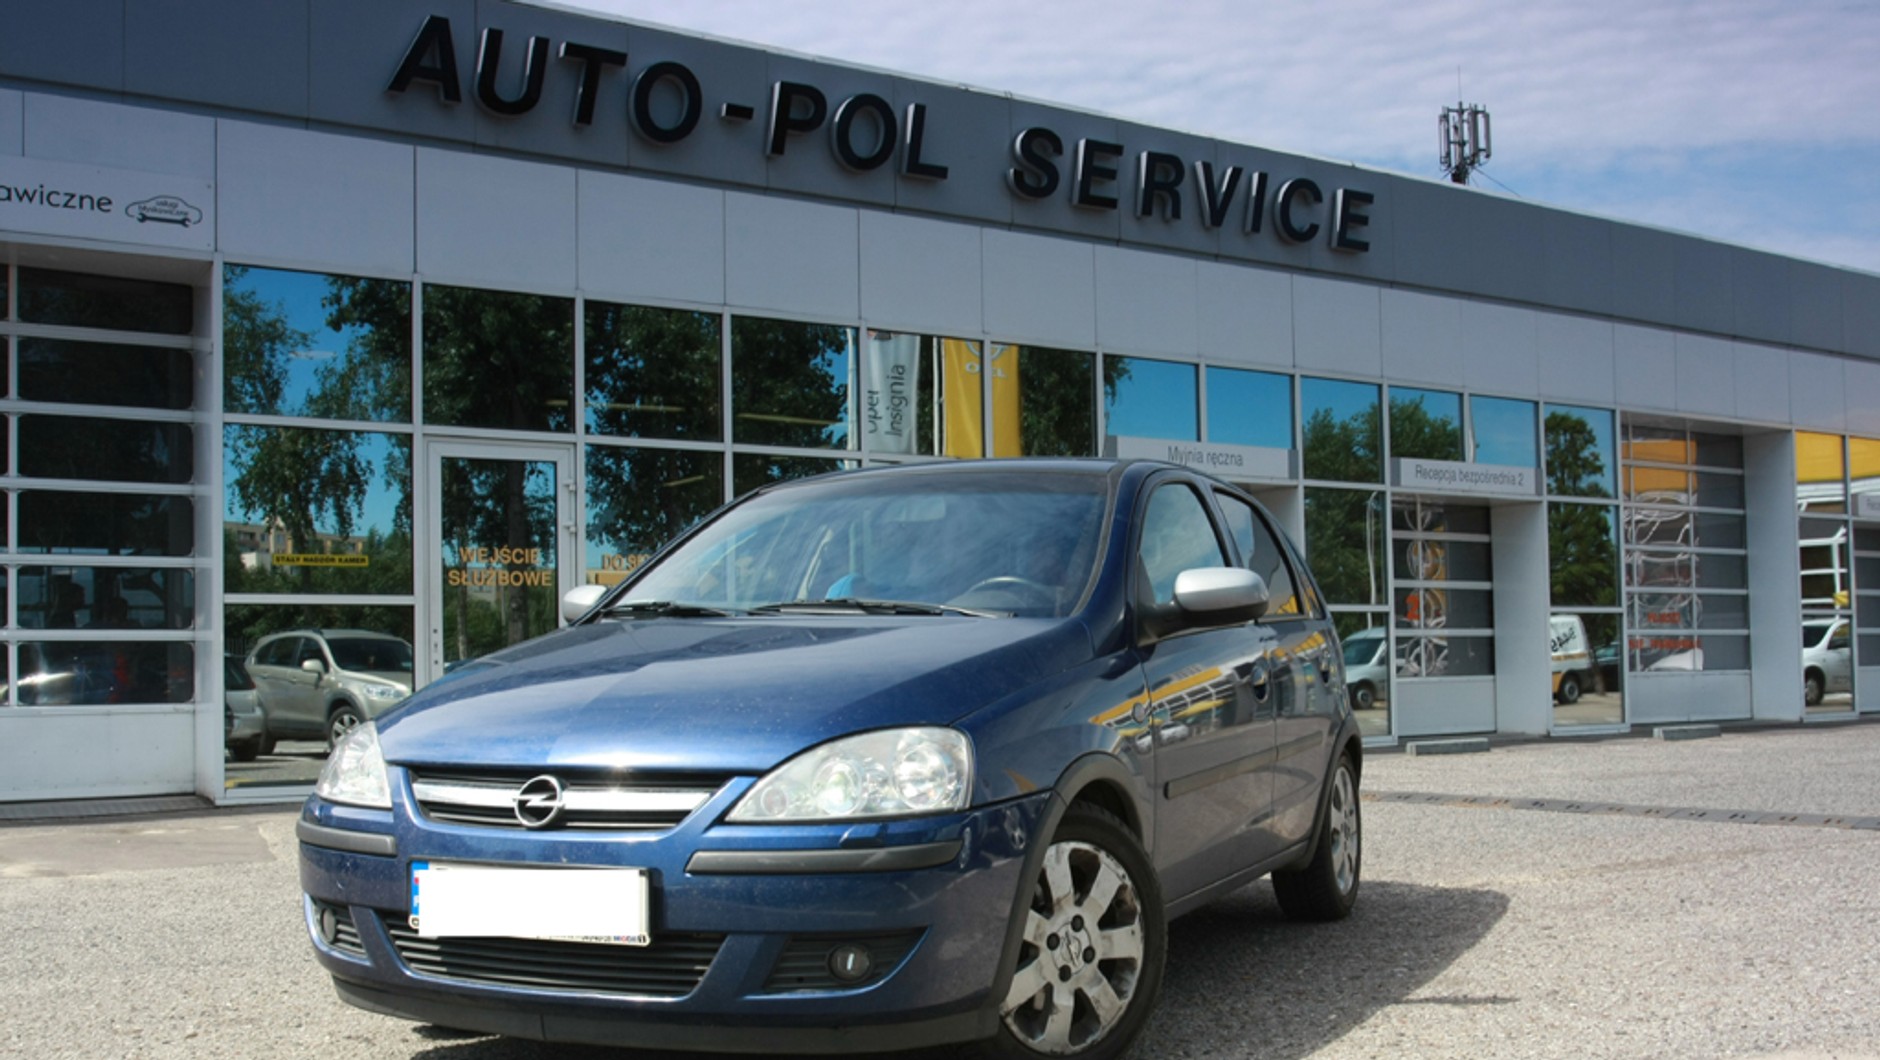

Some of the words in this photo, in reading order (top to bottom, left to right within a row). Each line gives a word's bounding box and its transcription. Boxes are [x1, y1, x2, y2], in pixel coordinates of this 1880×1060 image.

[0, 184, 113, 213] awiczne
[1007, 126, 1375, 253] SERVICE
[884, 364, 908, 438] Insignia
[1167, 446, 1204, 467] Myjnia
[1206, 452, 1244, 468] ręczna
[1415, 464, 1456, 484] Recepcja
[1518, 472, 1525, 486] 2
[459, 545, 541, 564] WEJŚCIE
[603, 553, 624, 570] DO
[448, 569, 552, 587] SŁUŻBOWE
